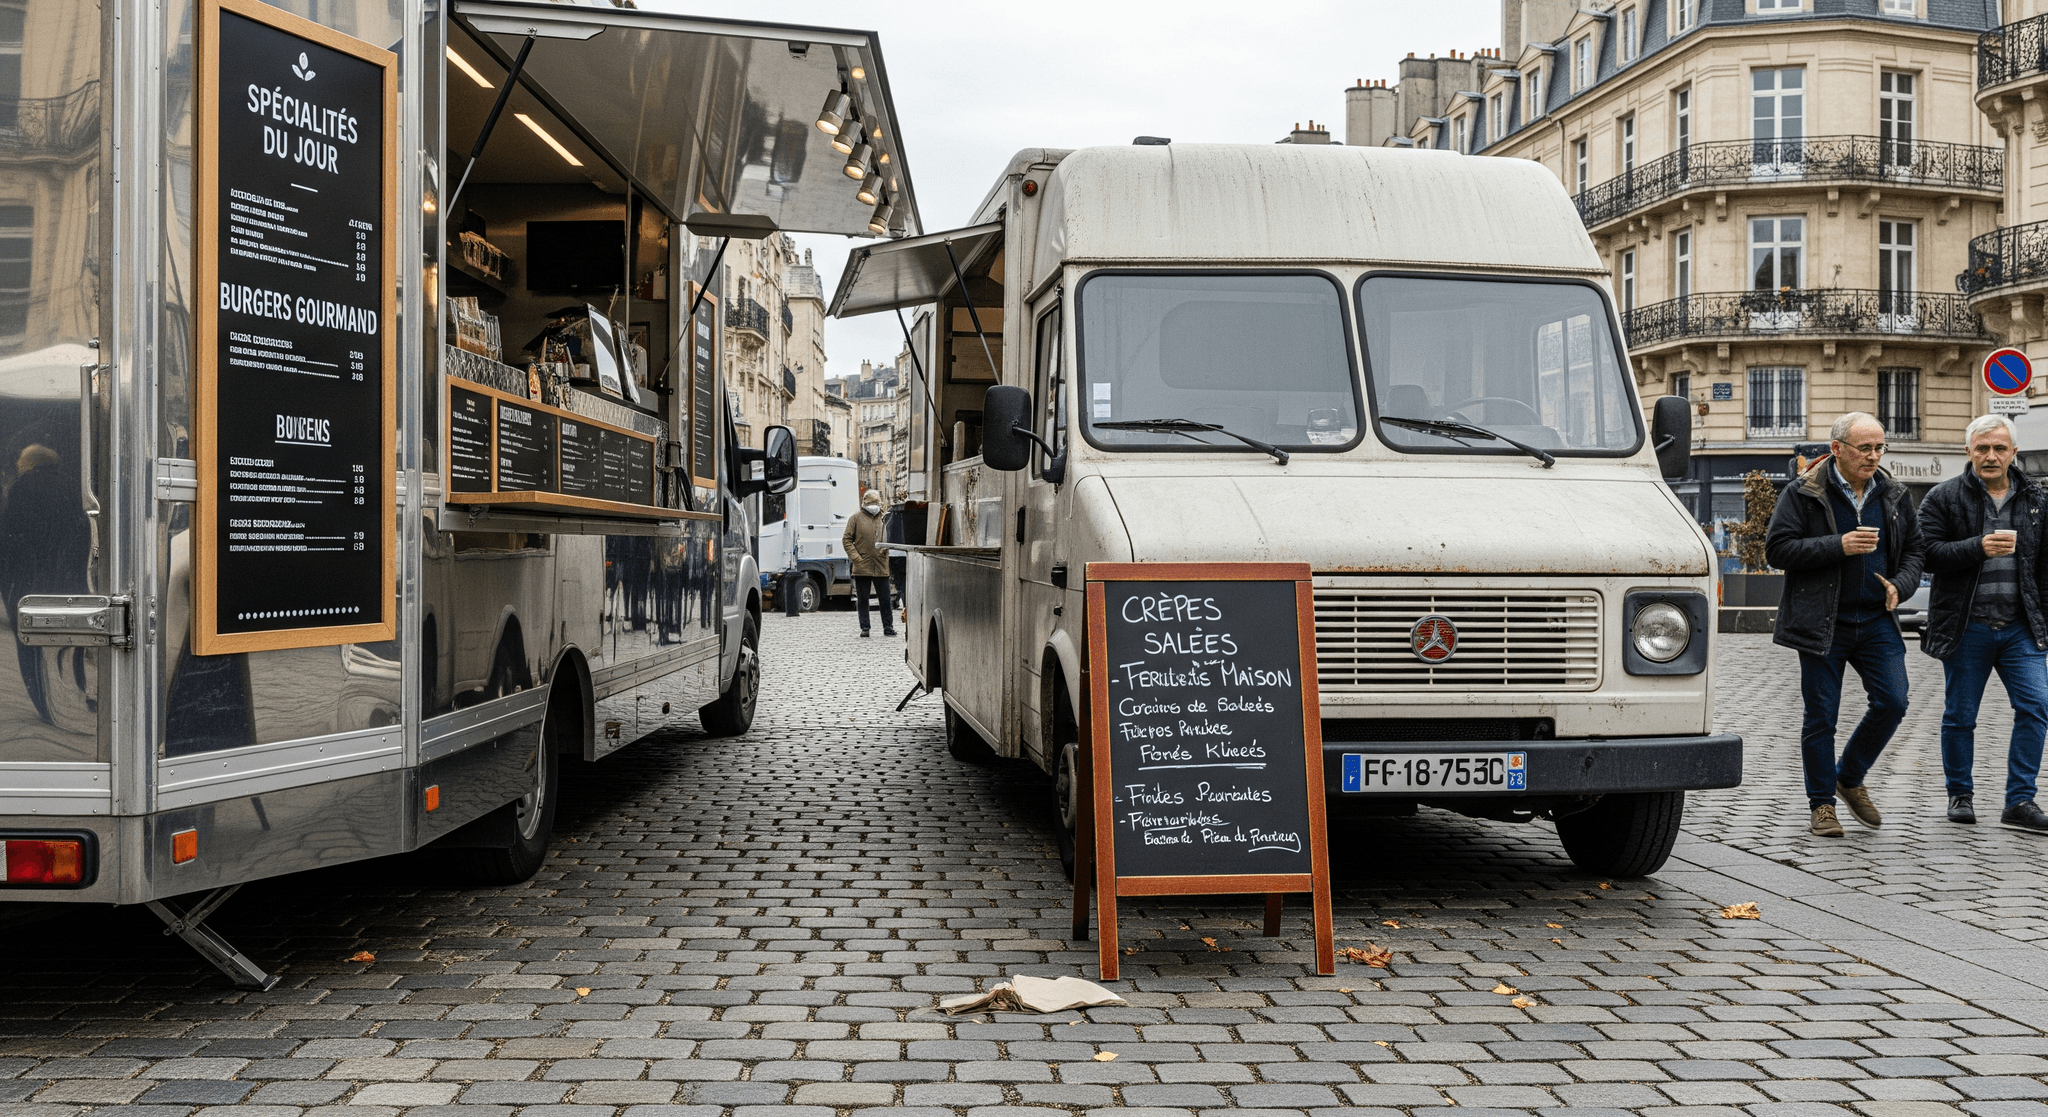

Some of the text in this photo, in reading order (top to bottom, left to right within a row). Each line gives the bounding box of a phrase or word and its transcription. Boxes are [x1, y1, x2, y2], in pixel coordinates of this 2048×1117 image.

[247, 84, 358, 144] SPÉCIALITÉS
[263, 126, 339, 174] DU JOUR
[220, 282, 377, 335] BURGERS GOURMAND
[1122, 592, 1222, 623] CRÈPES
